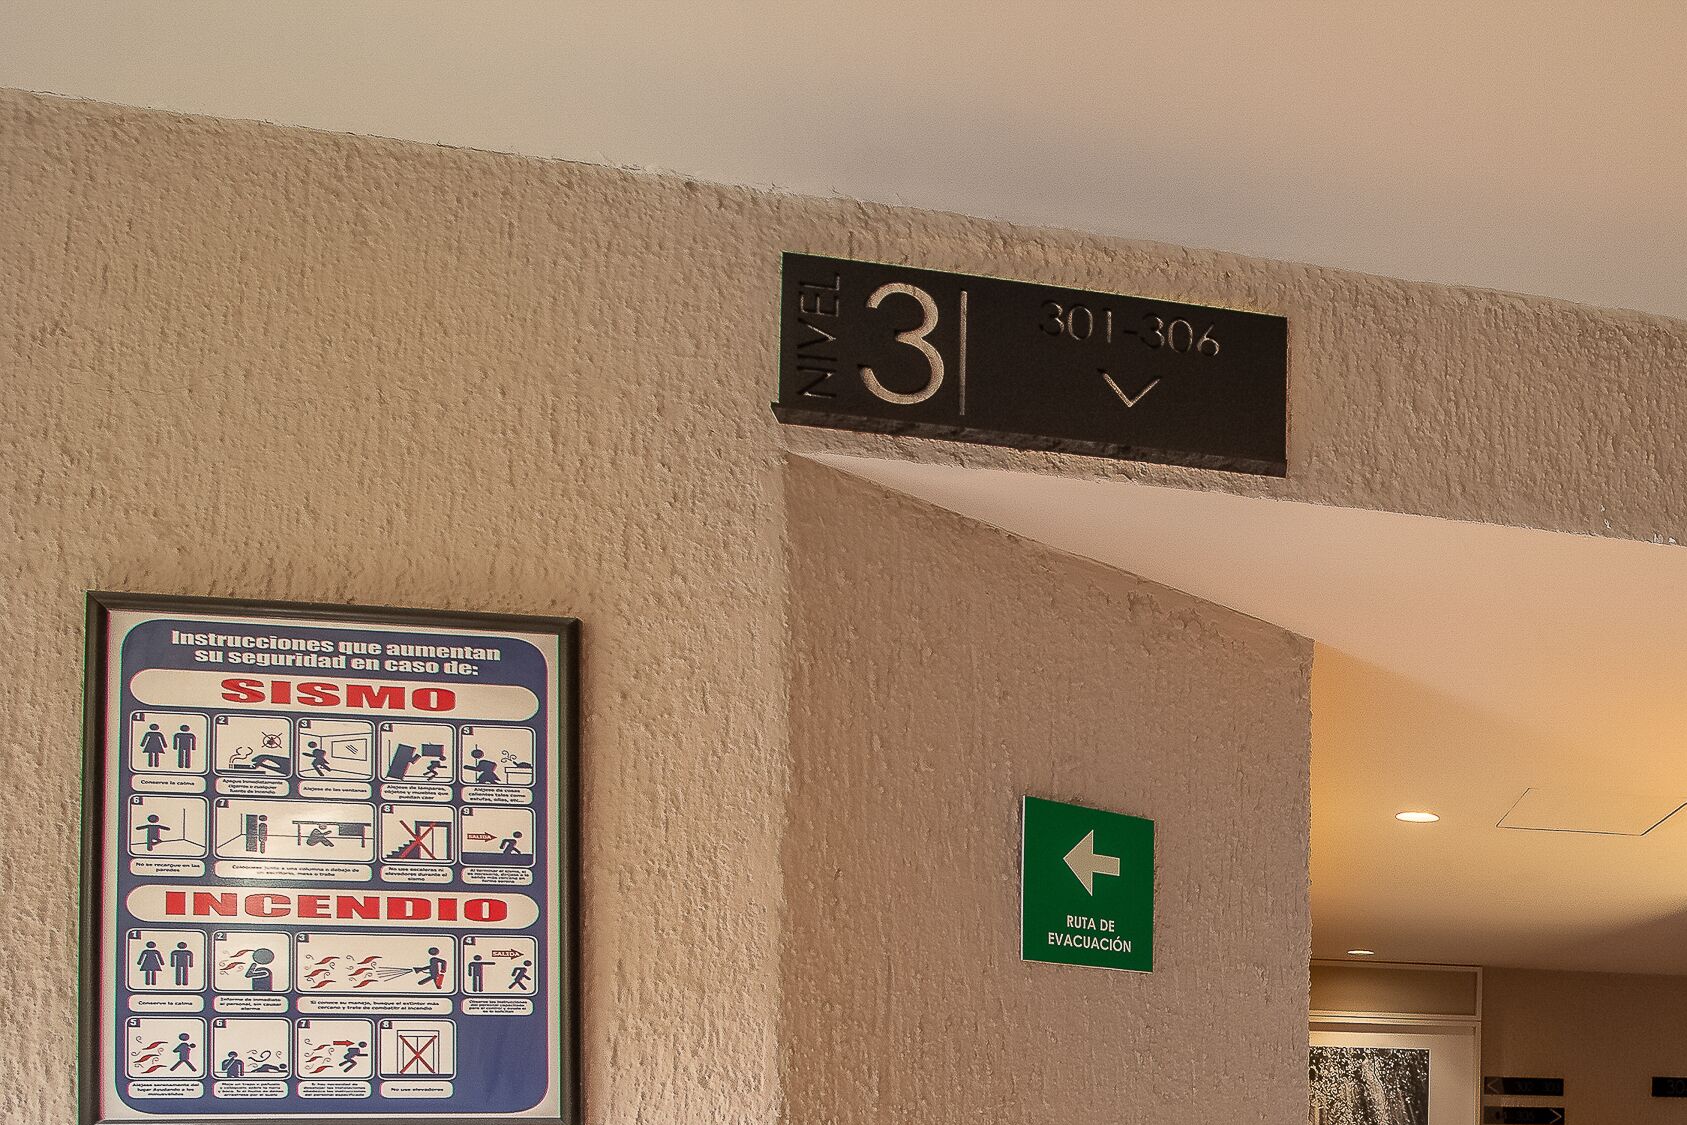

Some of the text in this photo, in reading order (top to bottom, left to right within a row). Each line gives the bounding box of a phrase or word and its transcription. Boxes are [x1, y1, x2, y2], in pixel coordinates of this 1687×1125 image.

[797, 273, 841, 399] NIVEL
[1039, 302, 1221, 357] 301-306
[860, 282, 945, 405] 3
[171, 630, 501, 661] Instrucciones que aumentan
[194, 650, 479, 676] su seguridad en caso de:
[220, 678, 457, 712] SISMO
[135, 713, 141, 721] 1
[218, 716, 225, 724] 2
[301, 720, 308, 728] 3
[384, 805, 391, 813] 8
[464, 807, 471, 815] 9
[166, 891, 508, 923] INCENDIO
[1067, 915, 1115, 932] RUTA DE
[298, 934, 306, 942] 3
[1048, 932, 1132, 953] EVACUACIÓN
[216, 1019, 223, 1027] 6
